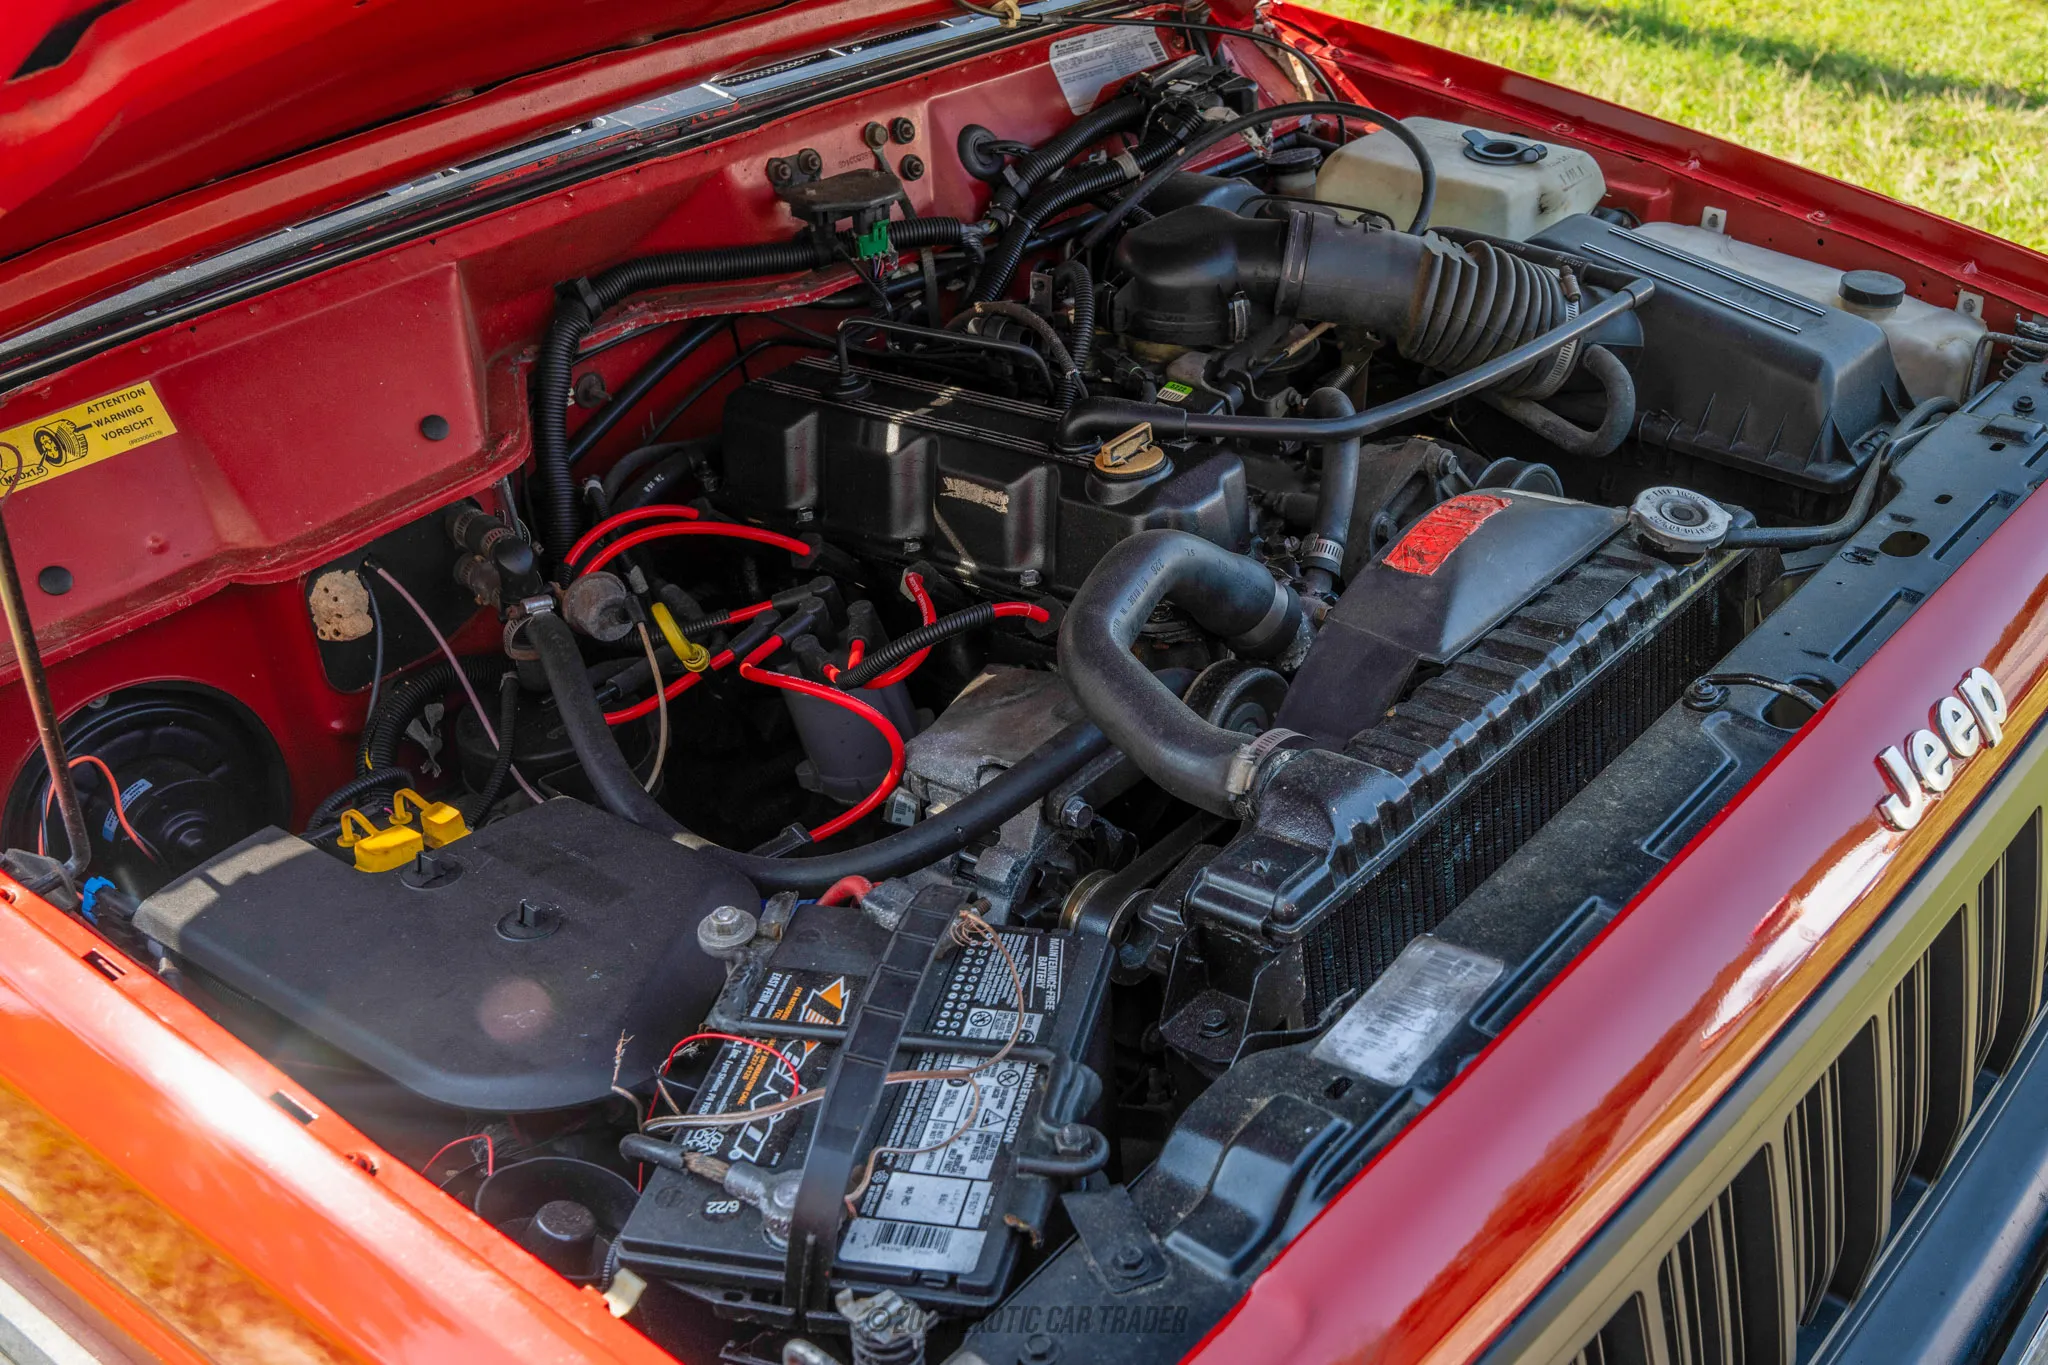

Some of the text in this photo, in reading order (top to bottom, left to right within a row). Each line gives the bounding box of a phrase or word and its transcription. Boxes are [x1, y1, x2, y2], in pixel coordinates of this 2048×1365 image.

[87, 388, 146, 415] ATTENTION
[92, 405, 145, 428] WARNING
[101, 417, 155, 441] VORSICHT
[3, 467, 44, 485] M0x1,5
[1874, 667, 2007, 830] Jeep
[766, 973, 781, 987] EAST
[1036, 956, 1047, 988] BATTERY
[1044, 938, 1060, 1009] MAINTENANCE-FREE
[758, 987, 773, 1002] PENN
[705, 1199, 739, 1213] 6/22
